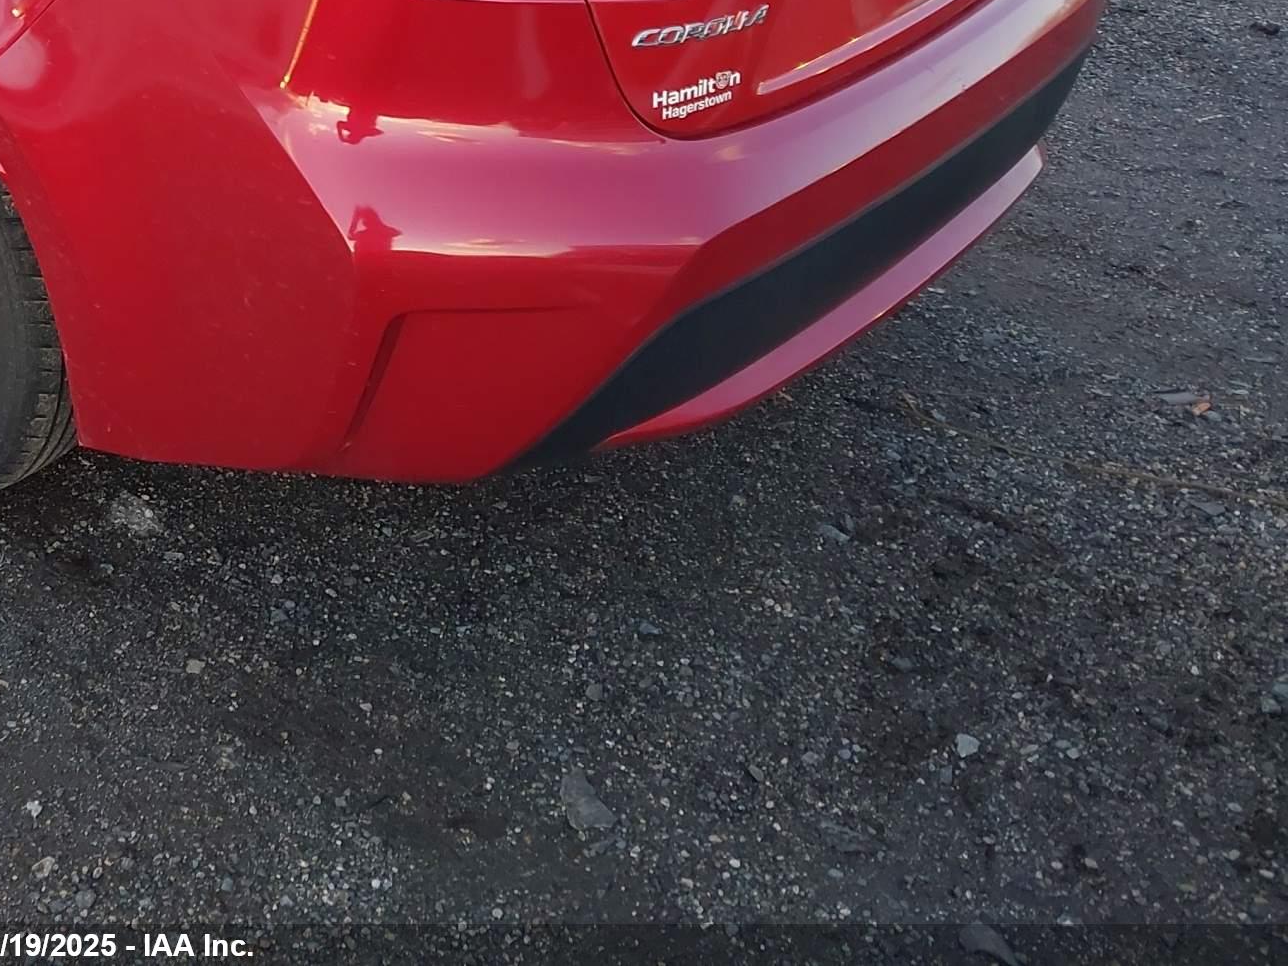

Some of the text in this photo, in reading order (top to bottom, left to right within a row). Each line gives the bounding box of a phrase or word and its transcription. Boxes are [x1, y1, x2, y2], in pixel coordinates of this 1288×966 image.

[632, 4, 770, 48] COROLLA
[652, 70, 741, 109] Hamilton
[662, 90, 733, 121] Hagerstown
